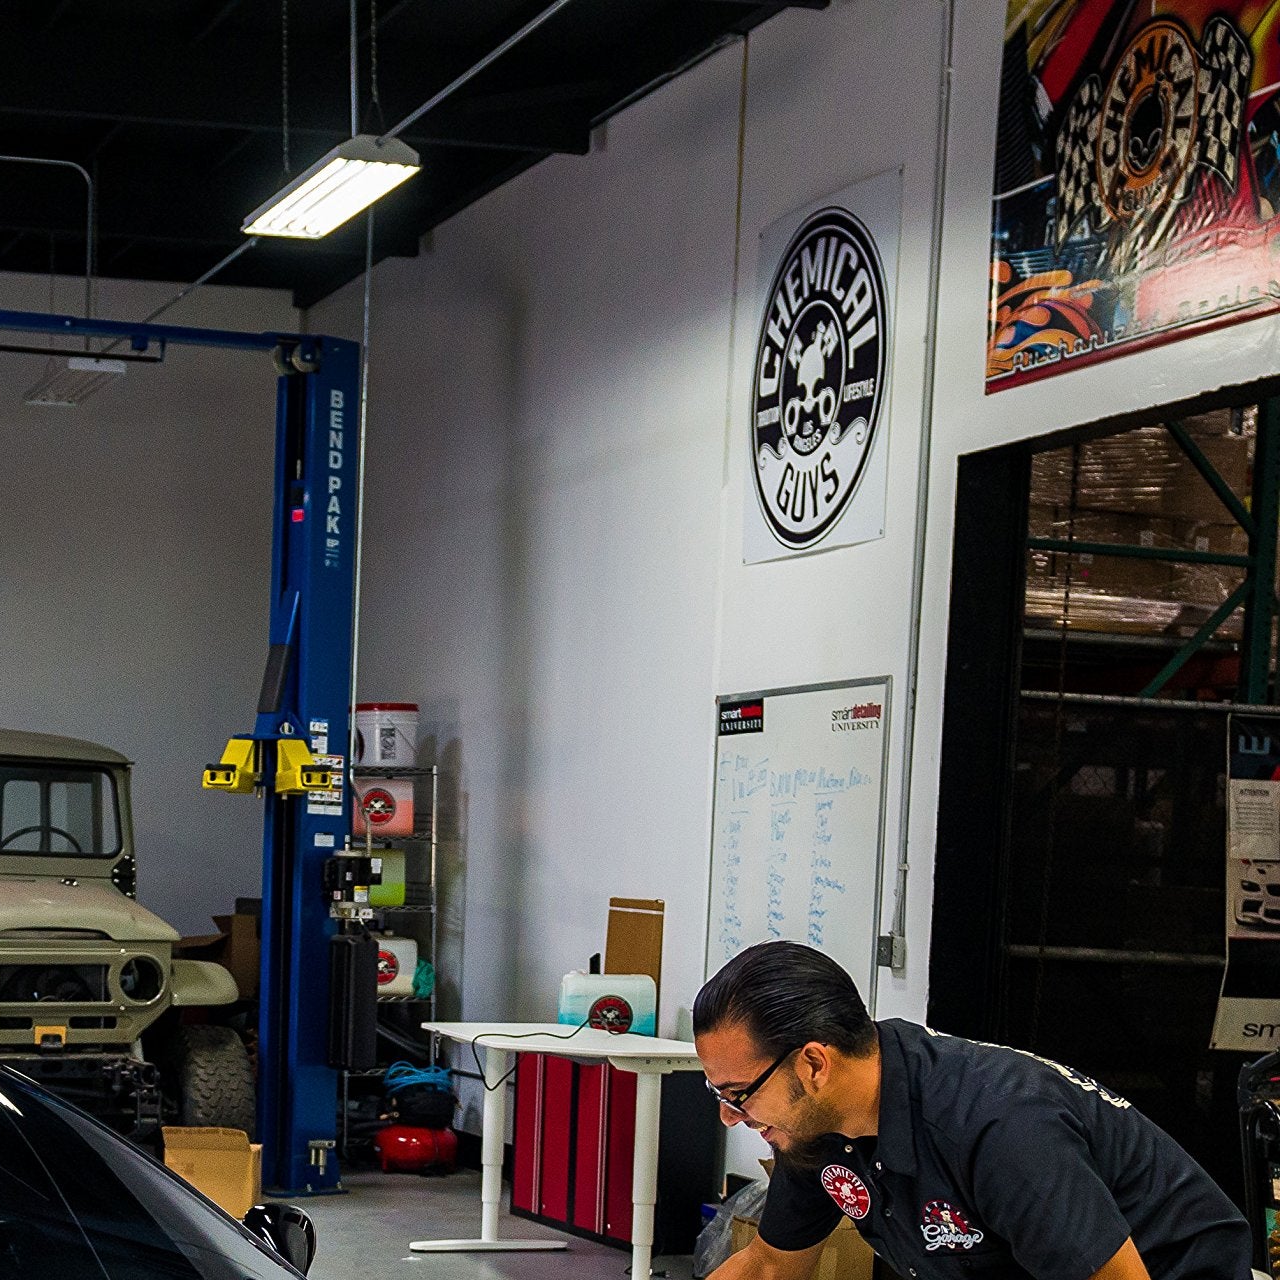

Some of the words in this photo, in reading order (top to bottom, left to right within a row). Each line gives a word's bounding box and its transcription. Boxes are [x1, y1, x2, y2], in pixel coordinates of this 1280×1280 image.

[759, 236, 877, 397] CHEMICAL
[776, 452, 839, 522] GUYS
[831, 720, 880, 731] UNIVERSITY
[823, 1167, 864, 1190] CHEMICAL
[920, 1224, 984, 1251] Garage
